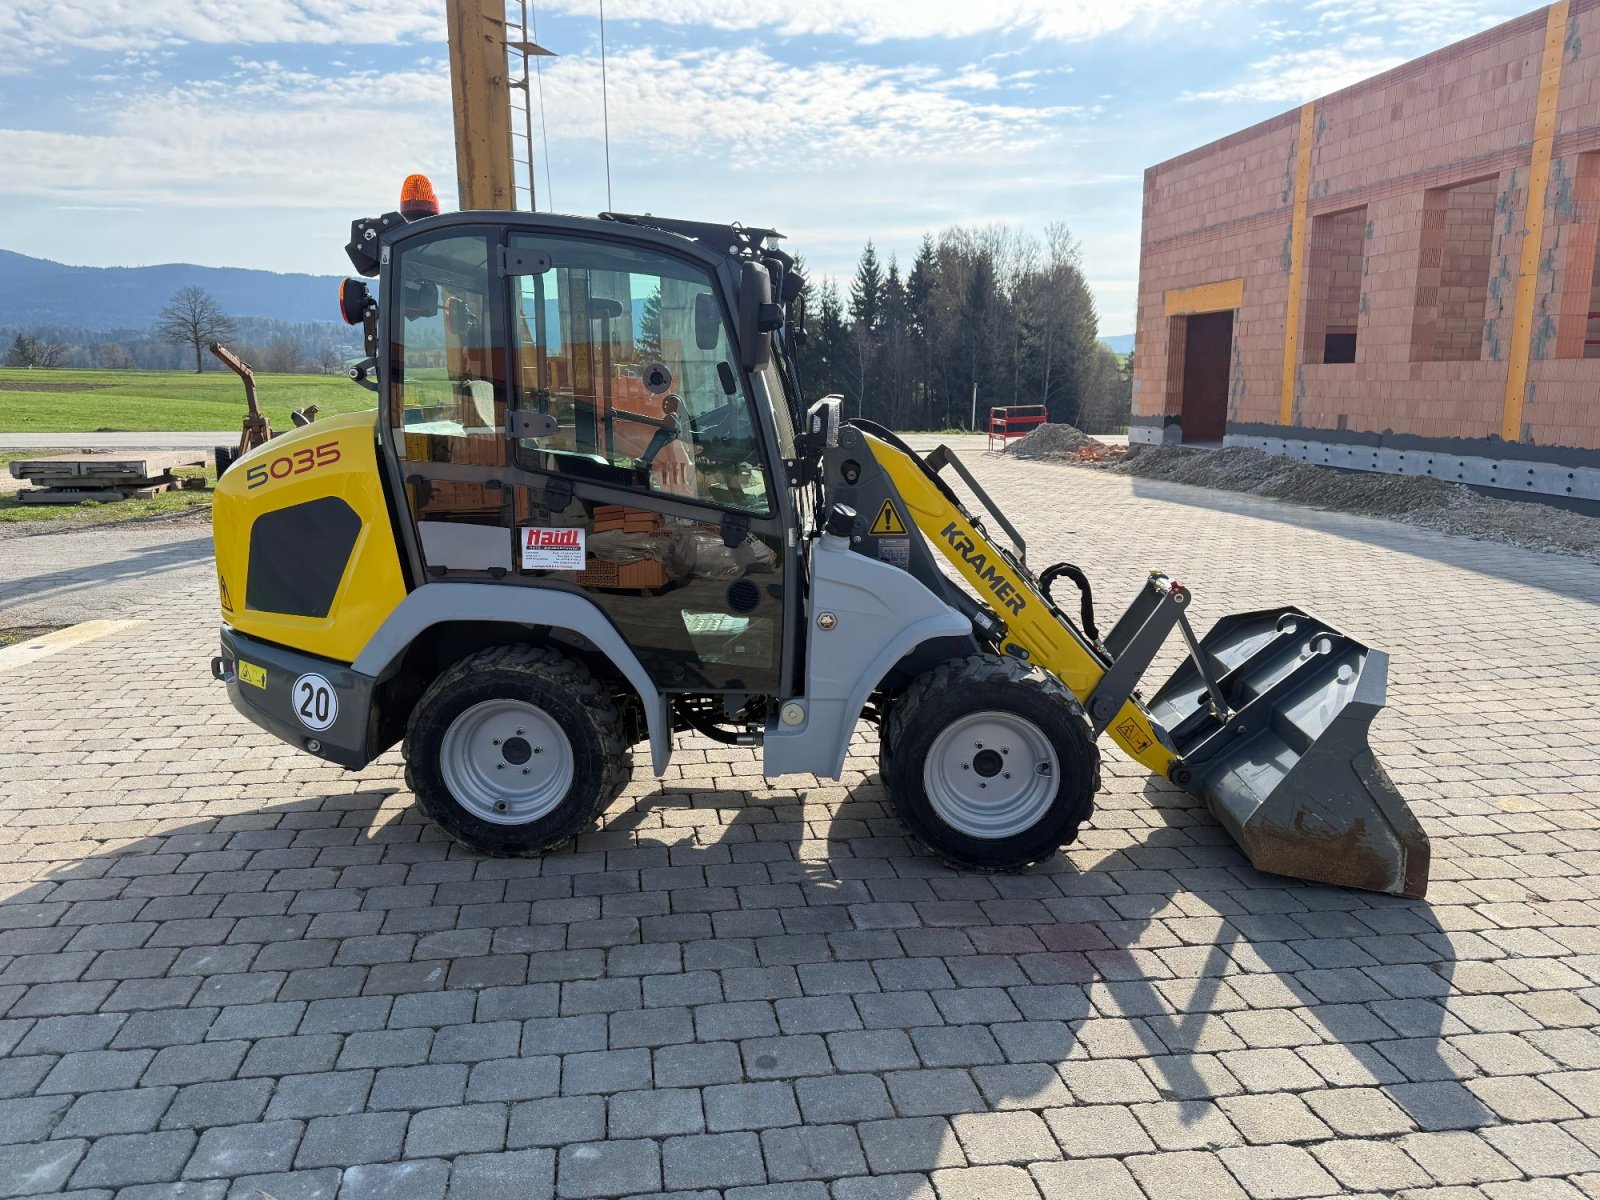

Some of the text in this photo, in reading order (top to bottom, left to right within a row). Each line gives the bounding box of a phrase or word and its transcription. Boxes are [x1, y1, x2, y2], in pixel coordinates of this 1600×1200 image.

[246, 440, 341, 490] 5035
[940, 521, 1026, 617] KRAMER
[300, 681, 330, 722] 20
